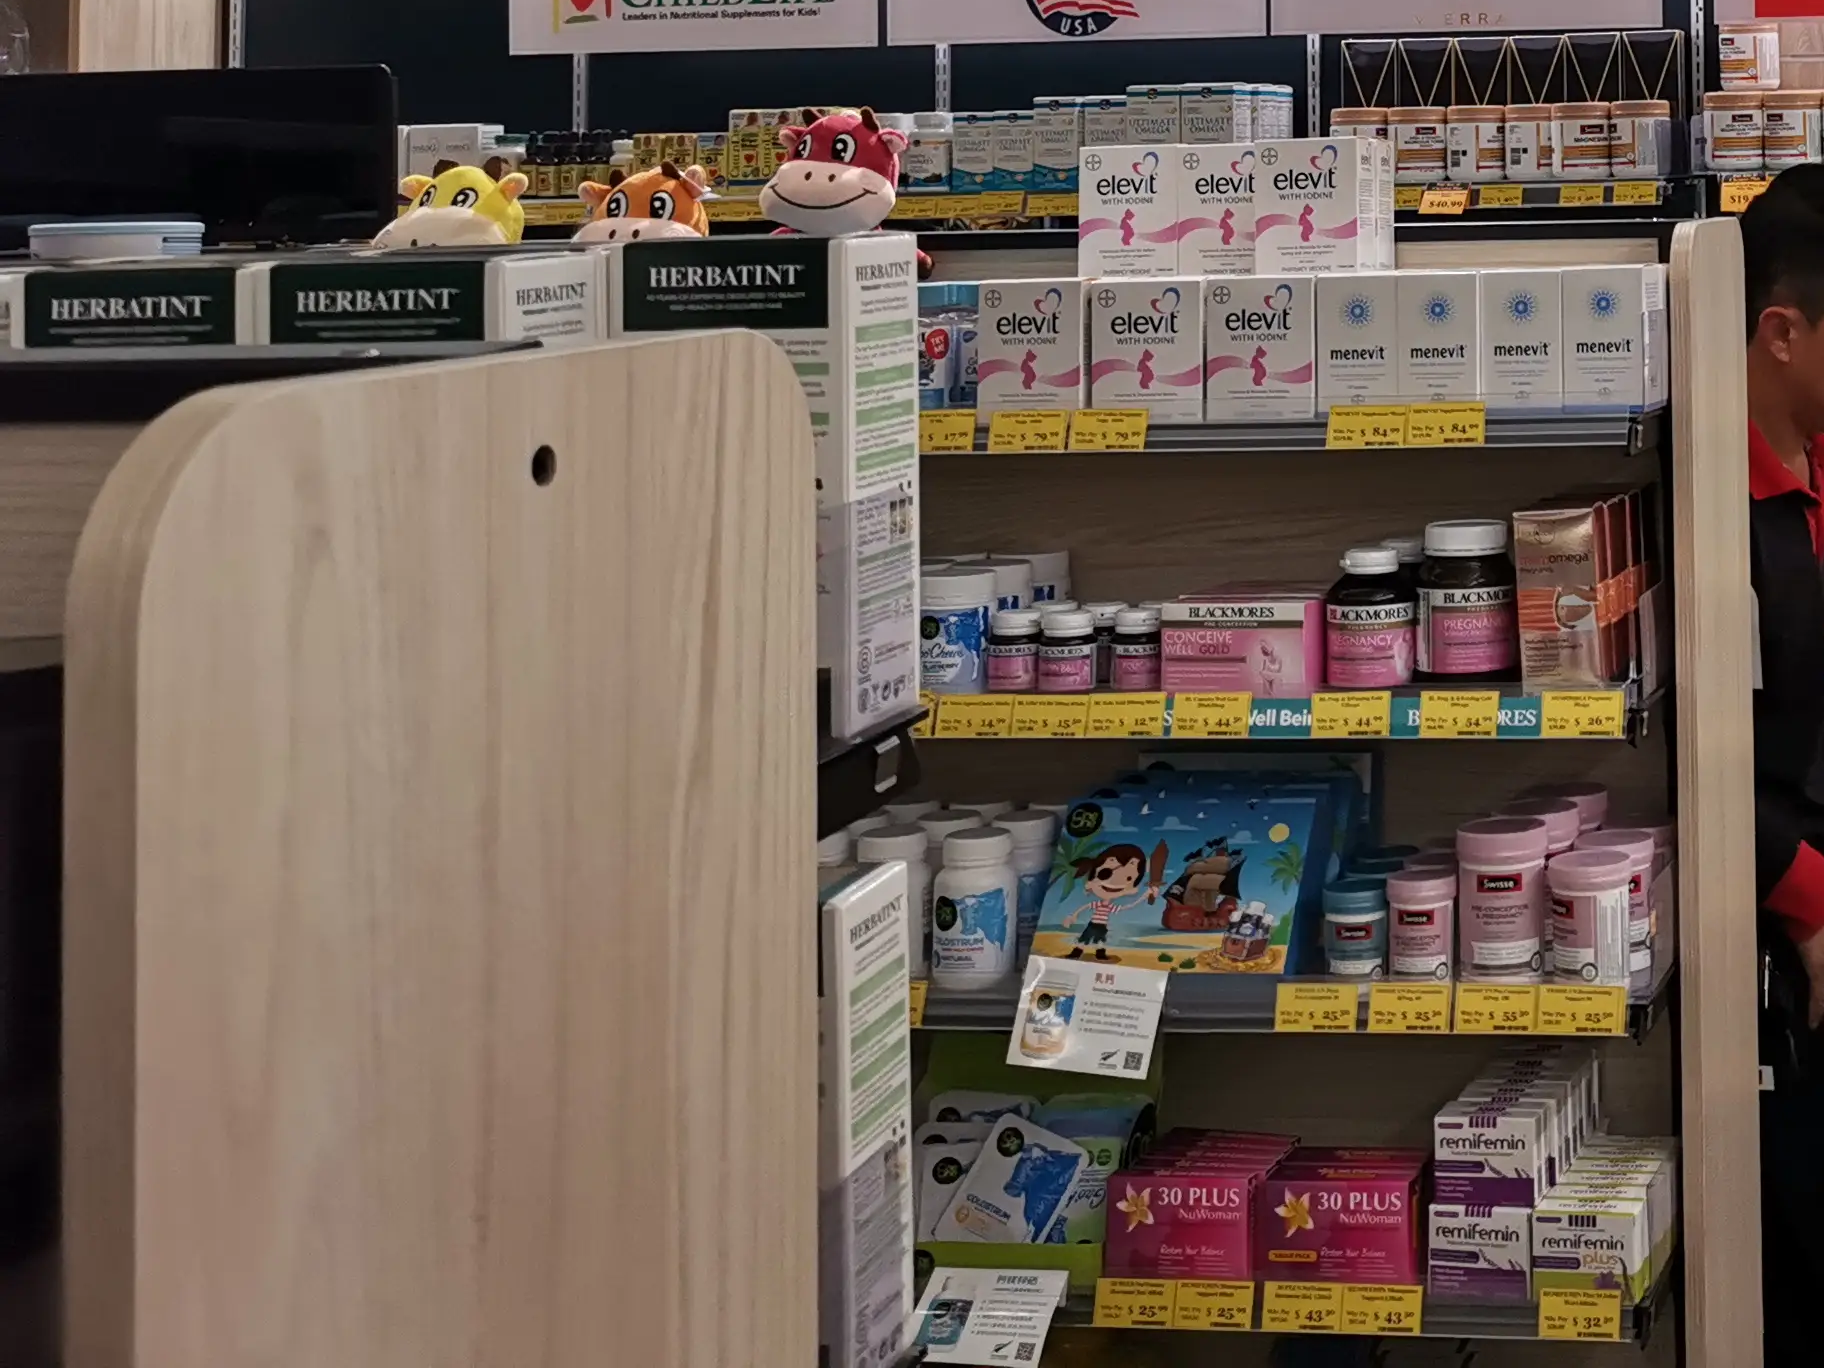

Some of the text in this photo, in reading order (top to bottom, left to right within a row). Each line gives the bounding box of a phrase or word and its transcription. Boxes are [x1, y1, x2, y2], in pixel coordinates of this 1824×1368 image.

[1060, 17, 1097, 35] USA
[1096, 174, 1157, 196] elevit
[1195, 173, 1255, 196] elevit
[1273, 167, 1337, 191] elevit
[648, 264, 801, 288] HERBATINT
[855, 260, 911, 282] HERBATINT
[296, 288, 454, 314] HERBATINT
[516, 281, 587, 307] HERBATINT
[51, 296, 206, 321] HERBATINT
[996, 311, 1061, 336] elevit
[1110, 310, 1181, 335] elevit
[1225, 307, 1292, 333] elevit
[1330, 345, 1386, 361] menevit
[1410, 343, 1466, 359] menevit
[1493, 341, 1549, 357] menevit
[1576, 338, 1632, 354] menevit
[1444, 589, 1513, 605] BLACKMO
[1188, 606, 1275, 619] BLACKMORES
[1164, 630, 1233, 645] CONCEIVE
[1164, 643, 1231, 655] WELL GOLD
[1482, 877, 1517, 891] Swisse
[1440, 1131, 1527, 1152] remifemin
[1157, 1187, 1241, 1208] 30 PLUS
[1317, 1192, 1402, 1212] 30 PLUS
[1179, 1208, 1240, 1221] NuWoman
[1340, 1212, 1402, 1225] NuWoman
[1435, 1223, 1521, 1244] remifemin
[1541, 1232, 1626, 1251] remifemin
[1582, 1252, 1621, 1269] plus
